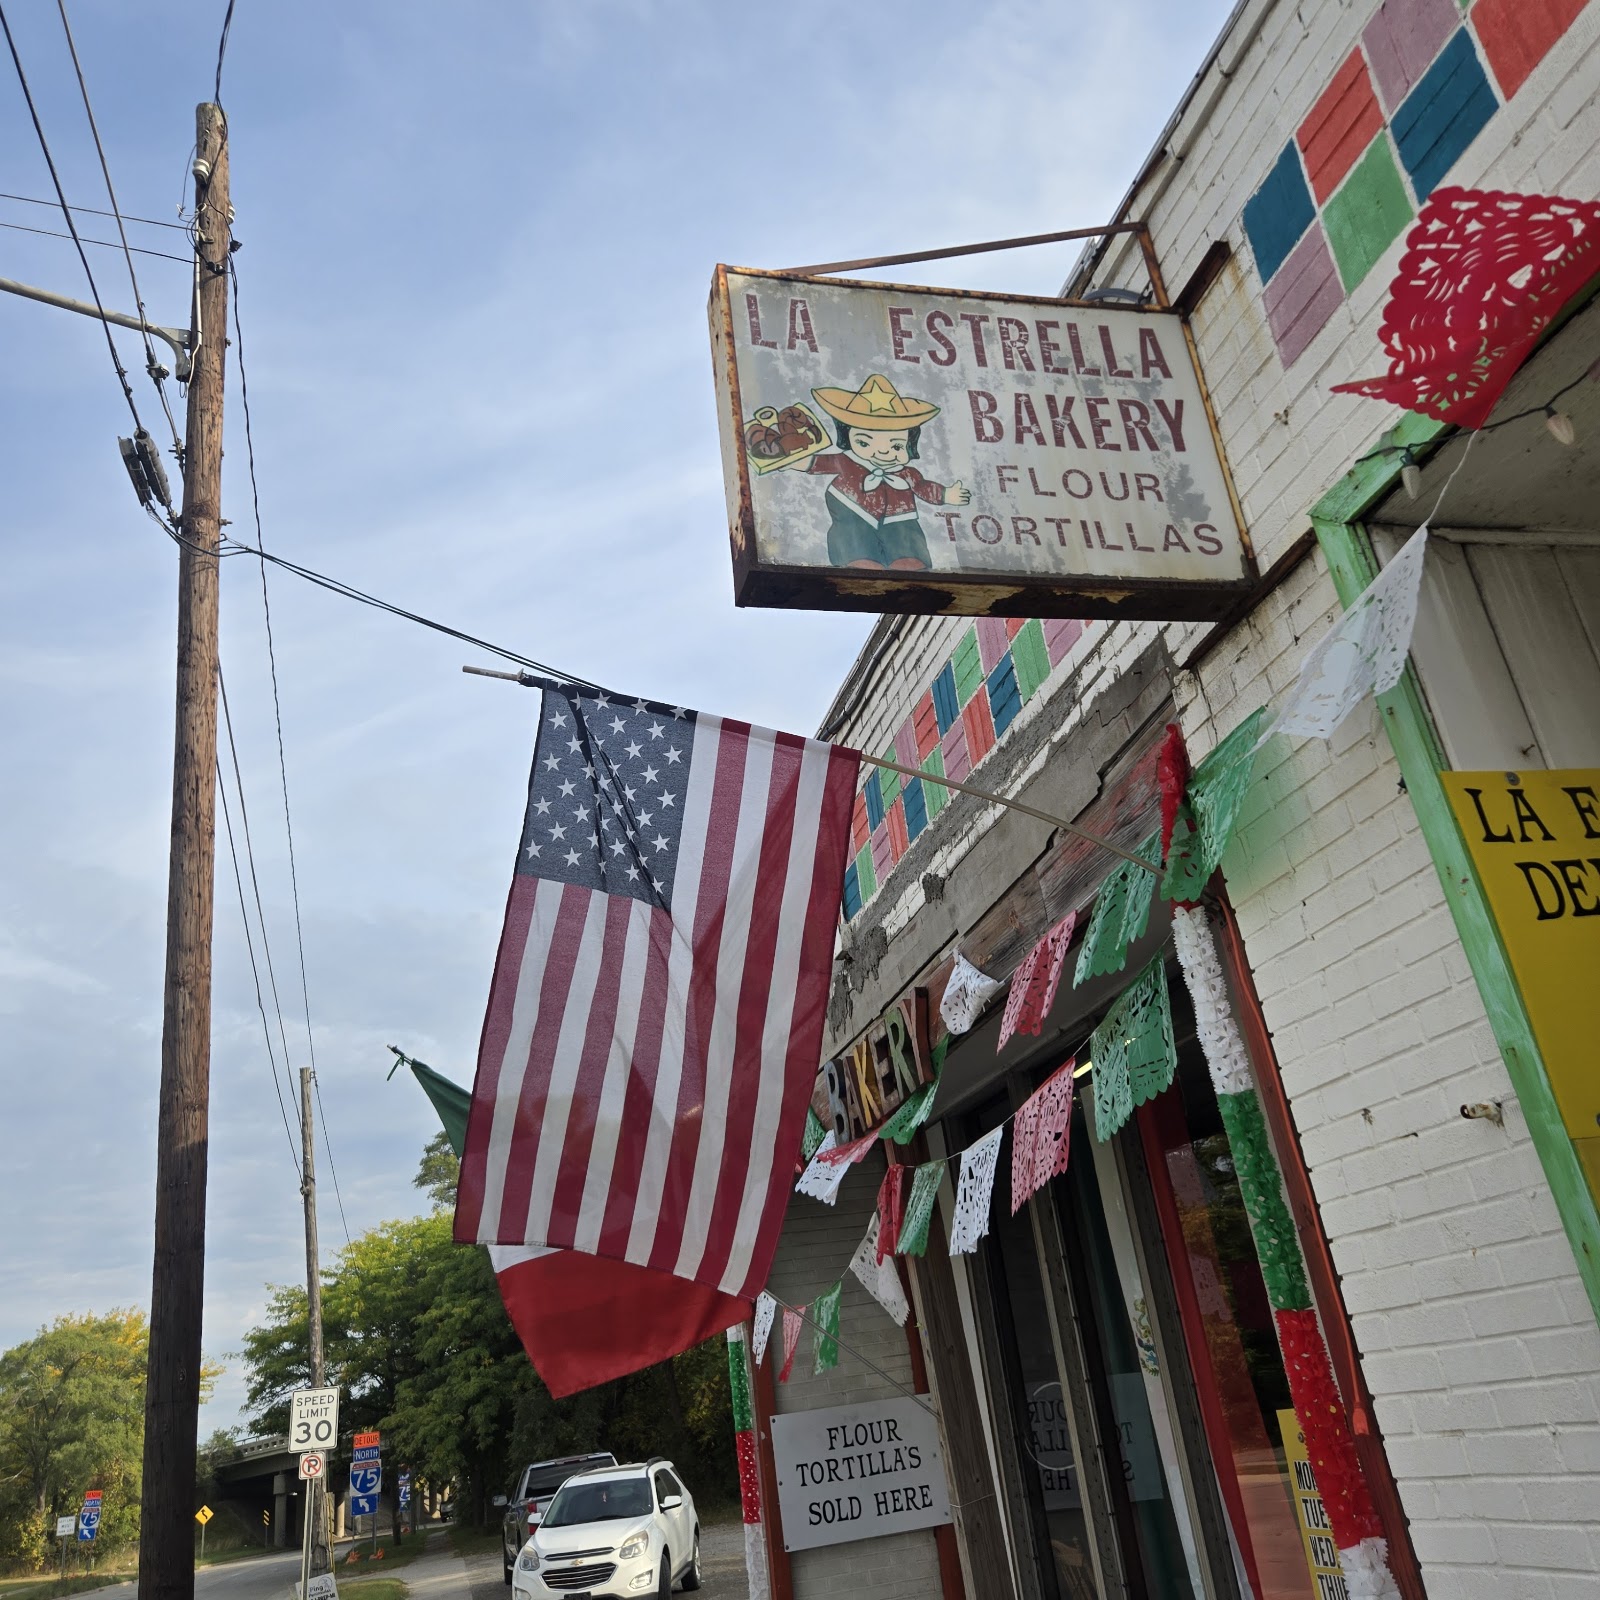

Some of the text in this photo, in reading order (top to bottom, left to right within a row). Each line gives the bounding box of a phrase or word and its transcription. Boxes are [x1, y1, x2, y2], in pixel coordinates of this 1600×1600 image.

[746, 293, 1173, 380] LA ESTRELLA
[966, 389, 1186, 453] BAKERY
[996, 464, 1165, 503] FLOUR
[935, 511, 1224, 556] TORTILLAS
[1463, 787, 1557, 844] LA
[824, 986, 935, 1147] BAKERY
[296, 1394, 335, 1407] SPEED
[299, 1407, 330, 1419] LIMIT
[294, 1419, 332, 1444] 30
[355, 1434, 379, 1446] DETOUR
[826, 1418, 903, 1450] FLOUR
[355, 1448, 379, 1460] NORTH
[796, 1446, 922, 1487] TORTILLA'S
[353, 1468, 378, 1489] 75
[82, 1512, 98, 1524] 75
[808, 1484, 933, 1526] SOLD HERE
